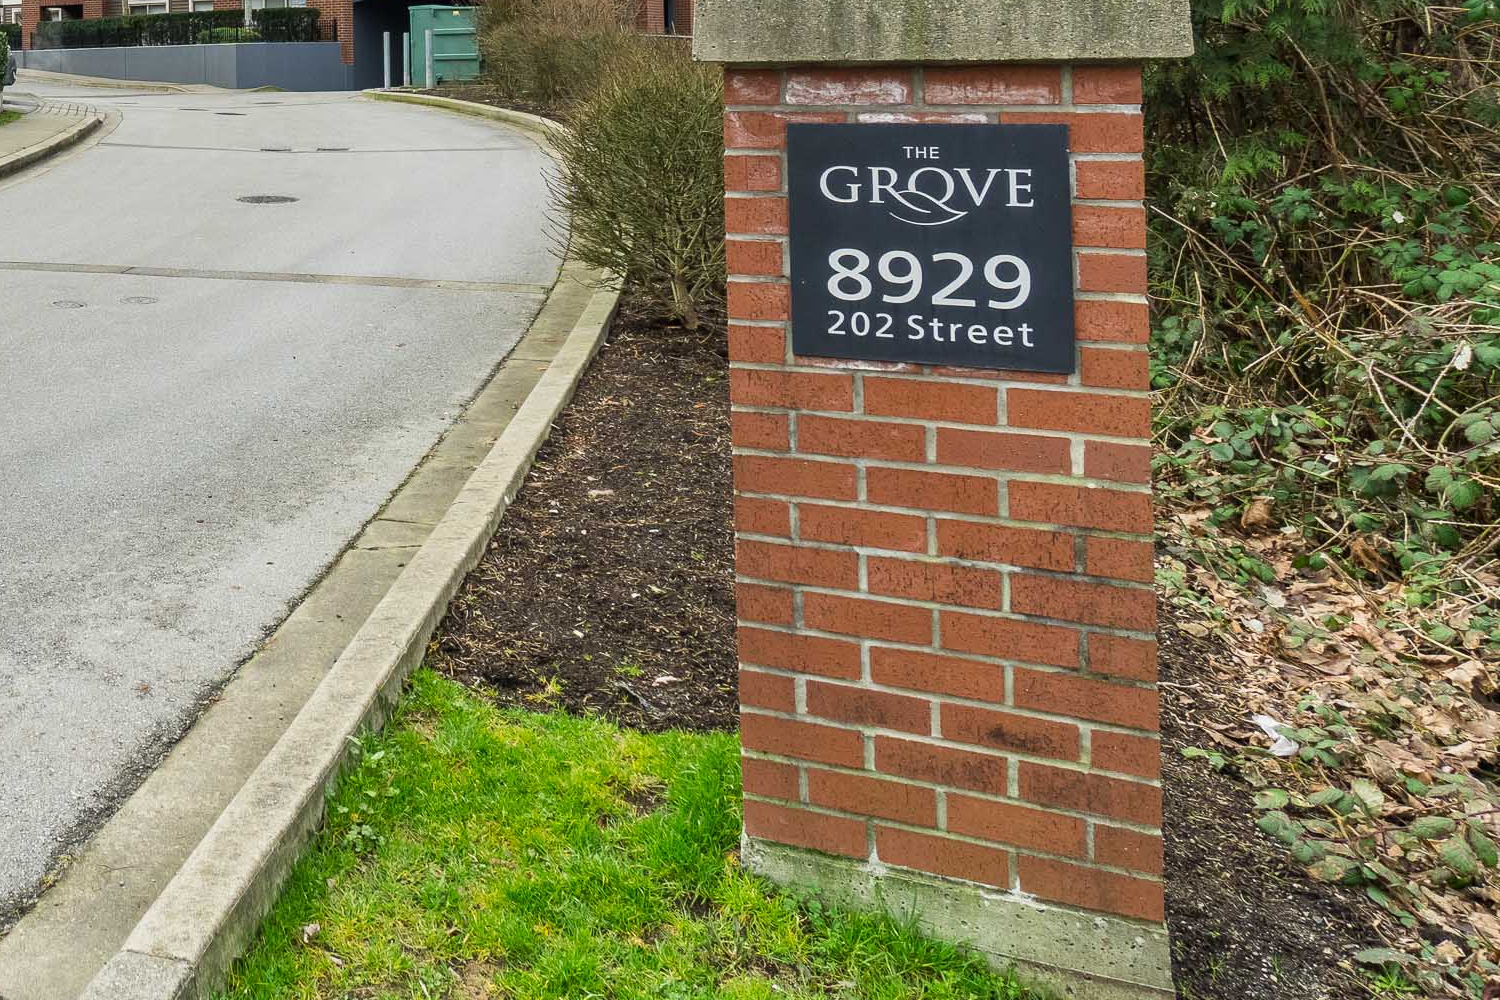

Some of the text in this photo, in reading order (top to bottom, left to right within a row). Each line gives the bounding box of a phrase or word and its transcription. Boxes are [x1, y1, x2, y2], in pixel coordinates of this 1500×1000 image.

[902, 146, 940, 160] THE
[819, 165, 1035, 212] GROVE
[826, 248, 1032, 310] 8929
[827, 310, 1035, 348] 202 Street
